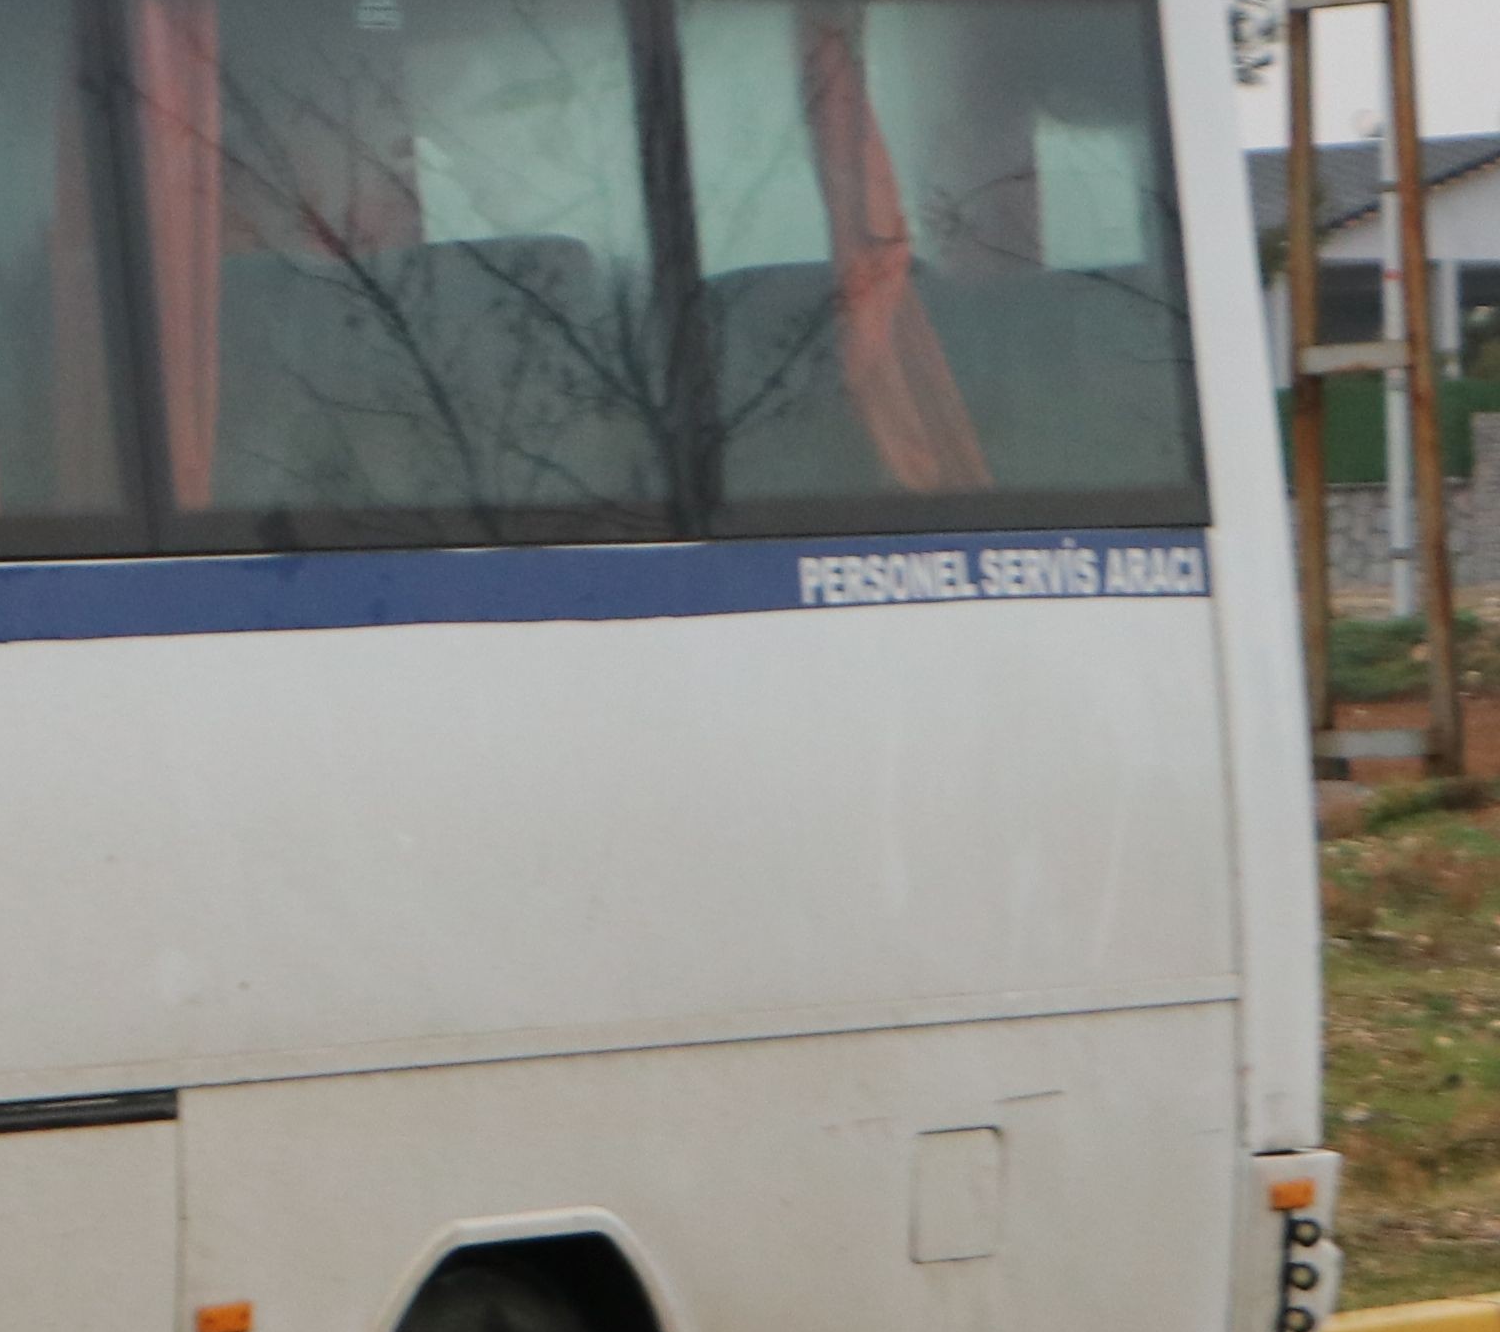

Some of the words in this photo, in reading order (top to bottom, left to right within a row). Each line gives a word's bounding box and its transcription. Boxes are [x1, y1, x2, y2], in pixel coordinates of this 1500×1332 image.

[799, 550, 980, 605] PERSONEL
[979, 537, 1100, 598] SERVİS
[1103, 546, 1204, 594] ARACI
